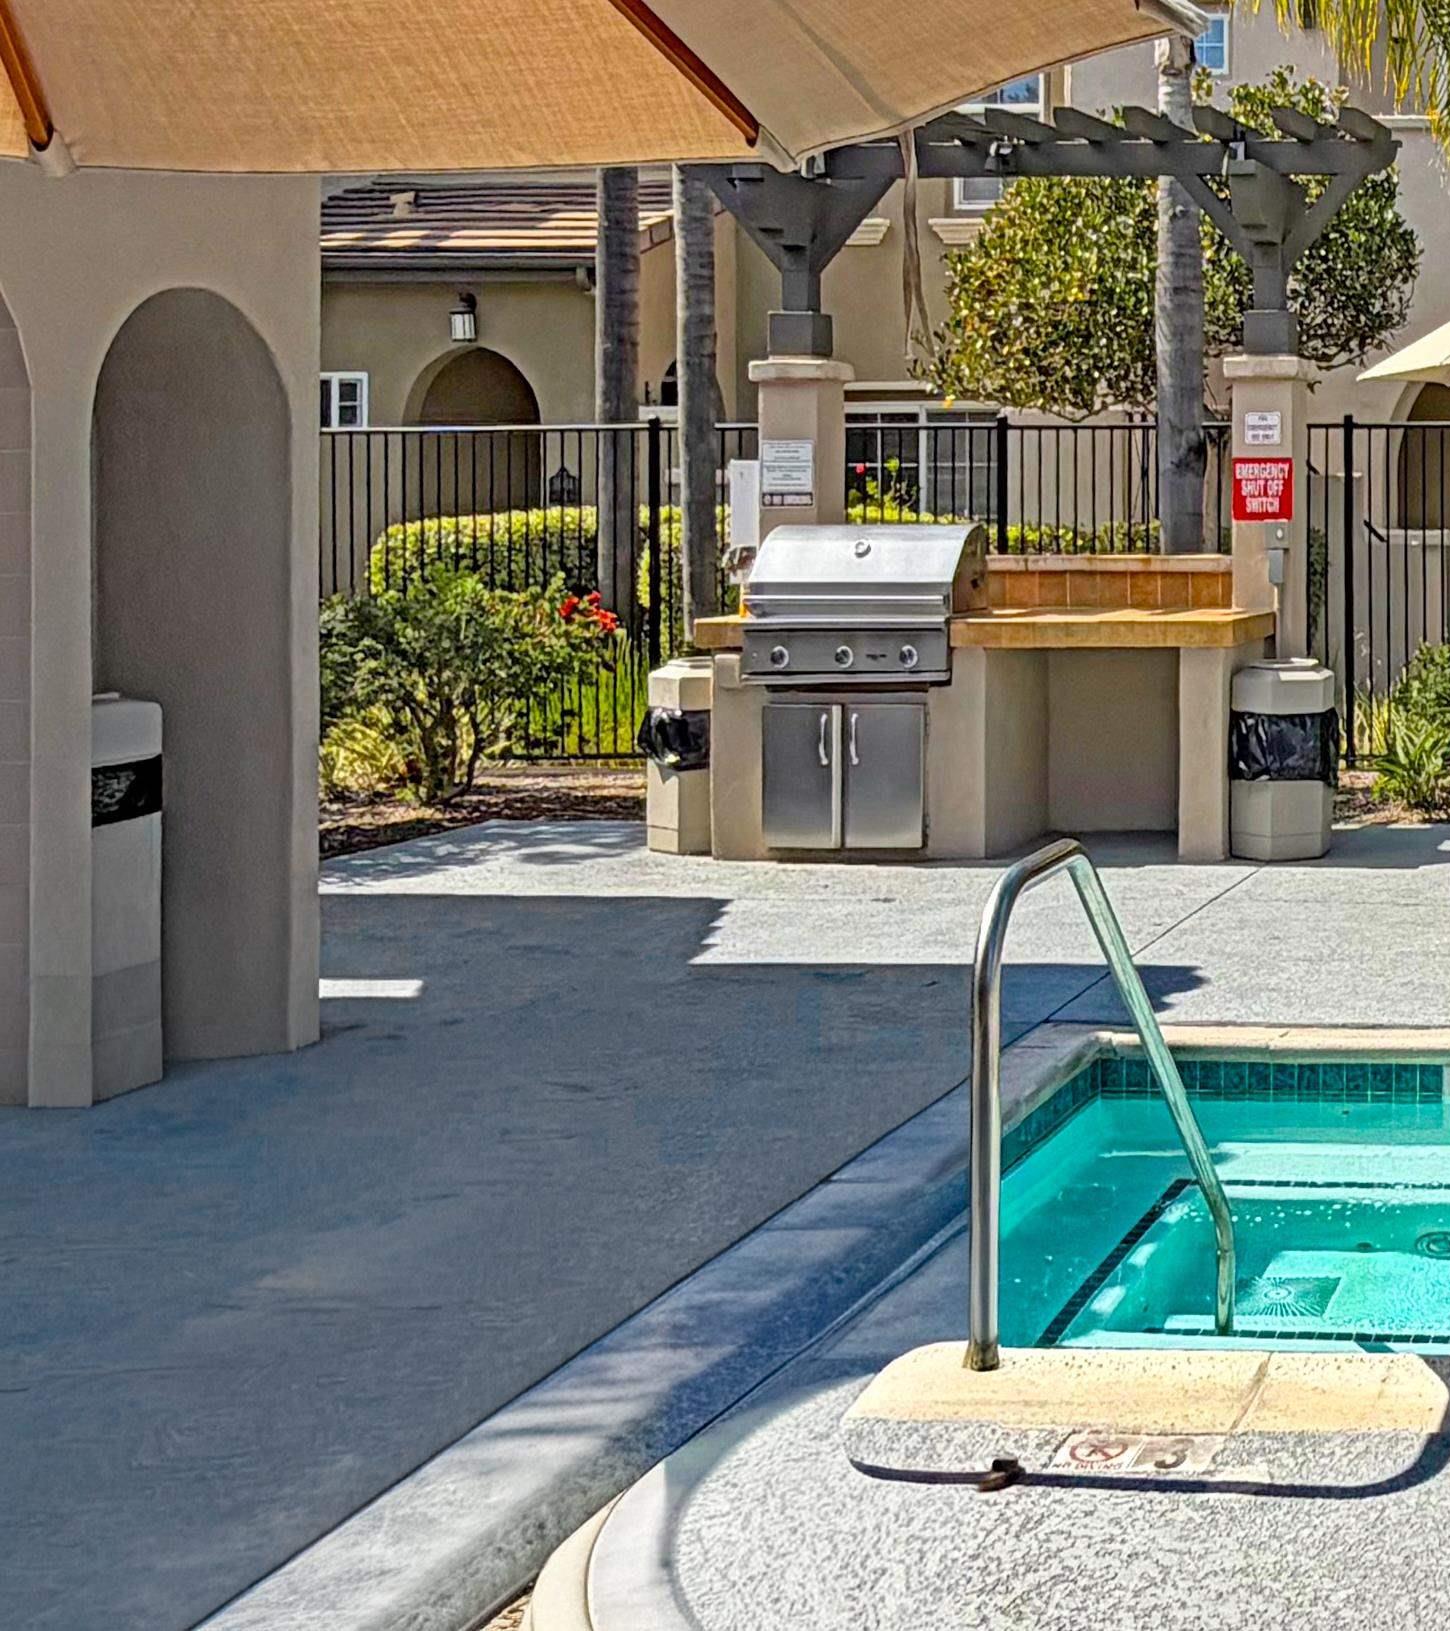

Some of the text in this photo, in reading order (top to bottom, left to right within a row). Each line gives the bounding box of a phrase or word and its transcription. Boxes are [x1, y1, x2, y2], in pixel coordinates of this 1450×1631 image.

[1235, 463, 1290, 479] EMERGENCY
[1241, 480, 1284, 496] SHUT OFF
[1246, 497, 1280, 513] SWITCH
[1154, 1438, 1195, 1469] 3
[1074, 1462, 1122, 1470] DIVING
